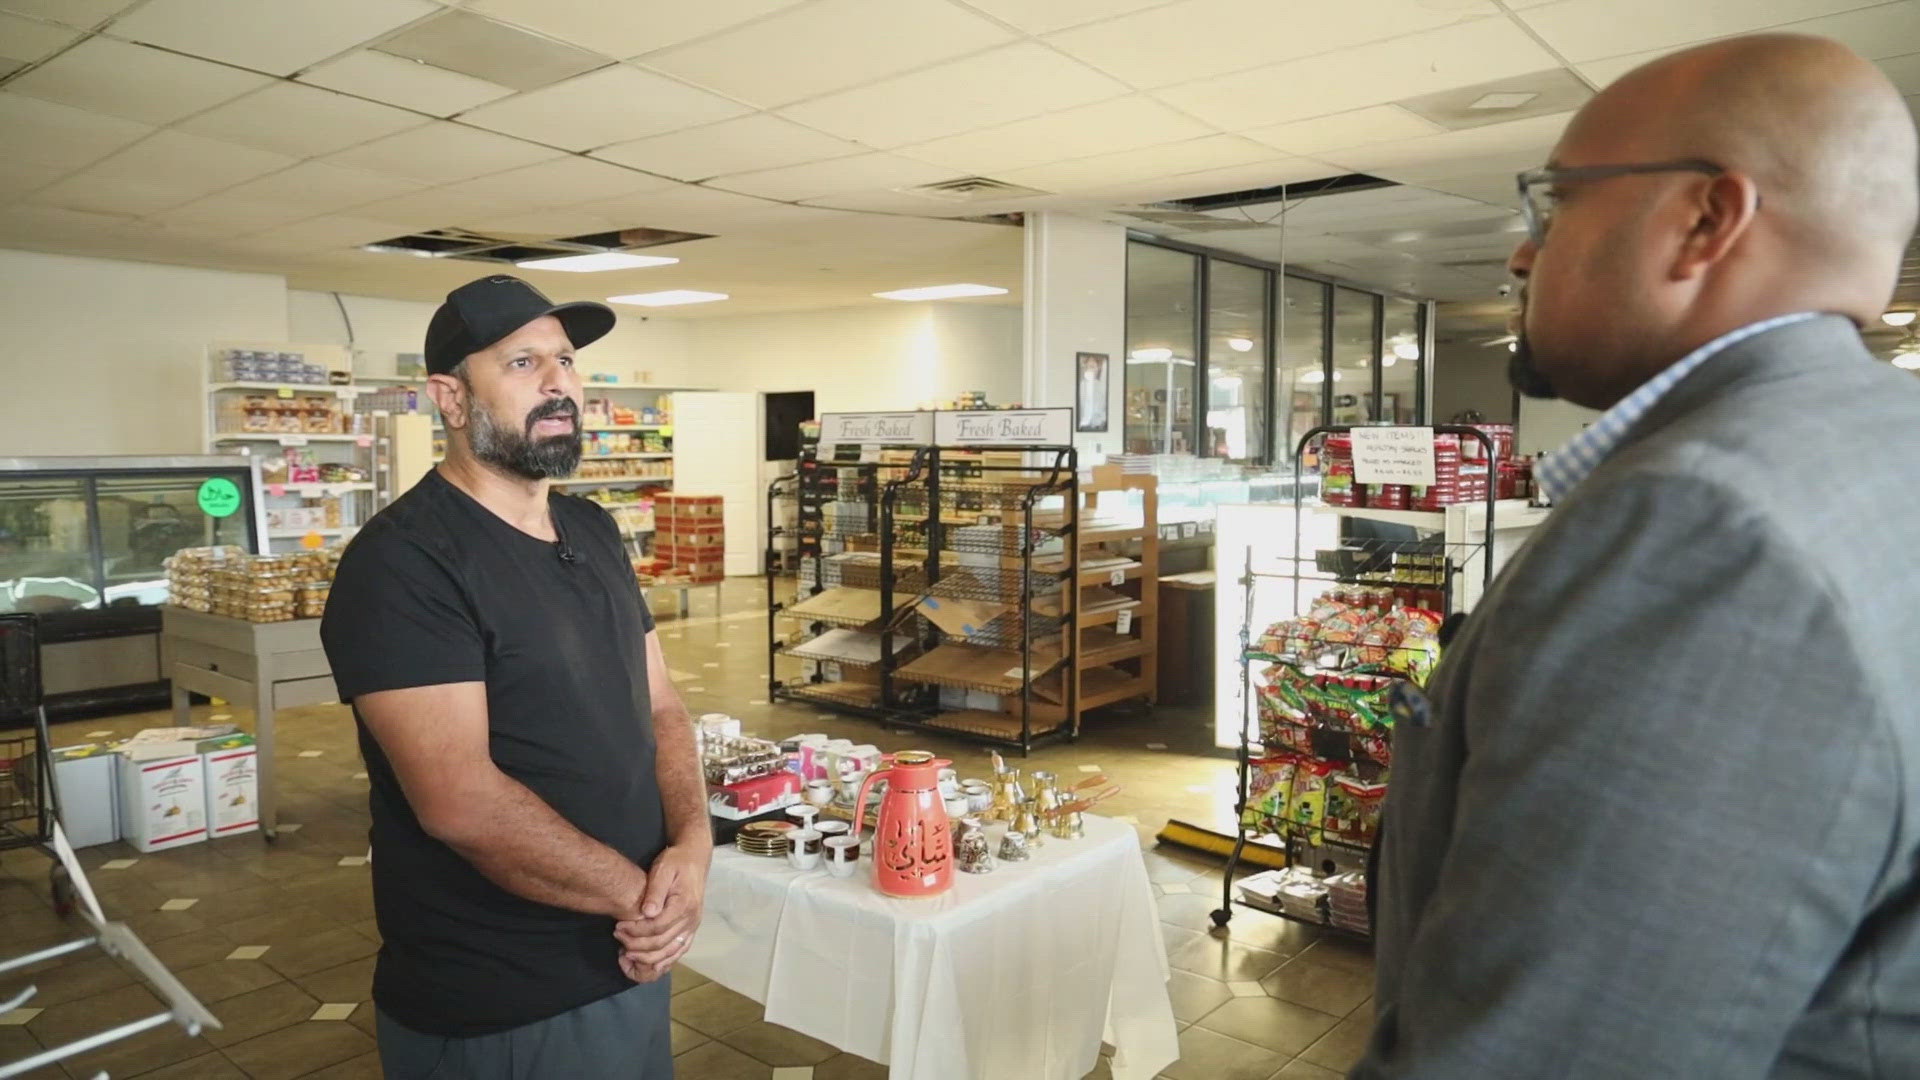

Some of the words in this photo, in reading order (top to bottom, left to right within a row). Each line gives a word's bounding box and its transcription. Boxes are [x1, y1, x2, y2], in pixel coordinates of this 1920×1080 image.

[840, 419, 871, 437] Fresh
[874, 418, 911, 437] Baked
[957, 419, 994, 437] Fresh
[1000, 417, 1042, 437] Baked
[1359, 431, 1379, 440] NEW
